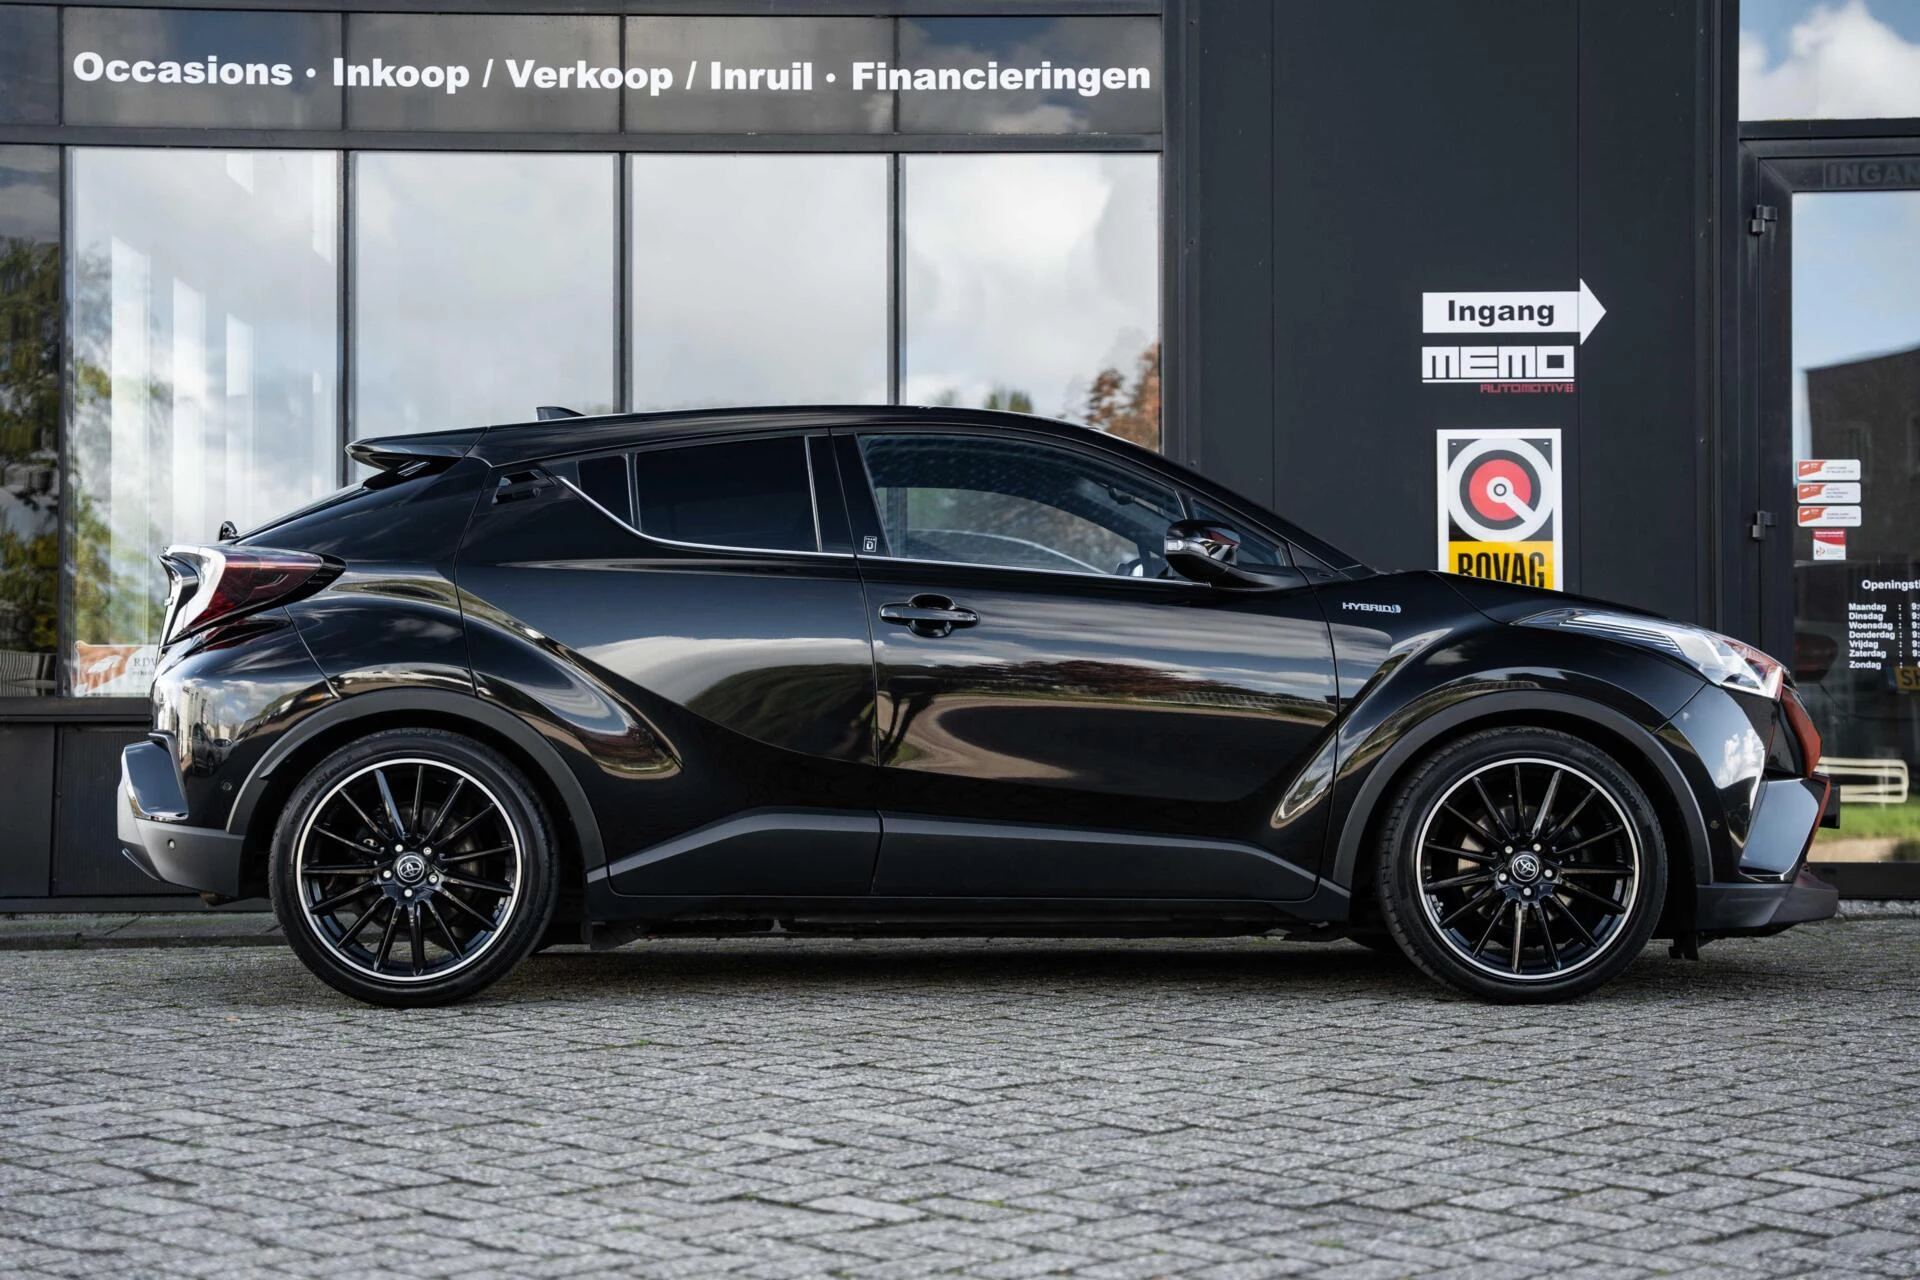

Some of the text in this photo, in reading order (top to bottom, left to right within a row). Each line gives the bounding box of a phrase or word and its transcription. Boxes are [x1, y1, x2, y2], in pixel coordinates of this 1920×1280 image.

[73, 52, 293, 86] Occasions
[333, 57, 470, 94] Inkoop
[505, 59, 674, 97] Verkoop
[710, 61, 813, 91] Inruil
[852, 61, 1151, 97] Financieringen
[1448, 300, 1555, 327] Ingang
[1421, 345, 1575, 379] MEMO
[1480, 383, 1575, 394] AUTOMOTIVE
[1342, 601, 1393, 614] HYBRID
[1848, 602, 1887, 612] Maandag
[1848, 611, 1884, 622] Dinsdag
[1848, 621, 1894, 631] Woensdag
[1848, 630, 1896, 641] Donderdag
[1848, 639, 1879, 649] Vrijdag
[1848, 649, 1887, 659] Zaterdag
[134, 657, 156, 667] RD
[1848, 660, 1882, 670] Zondag
